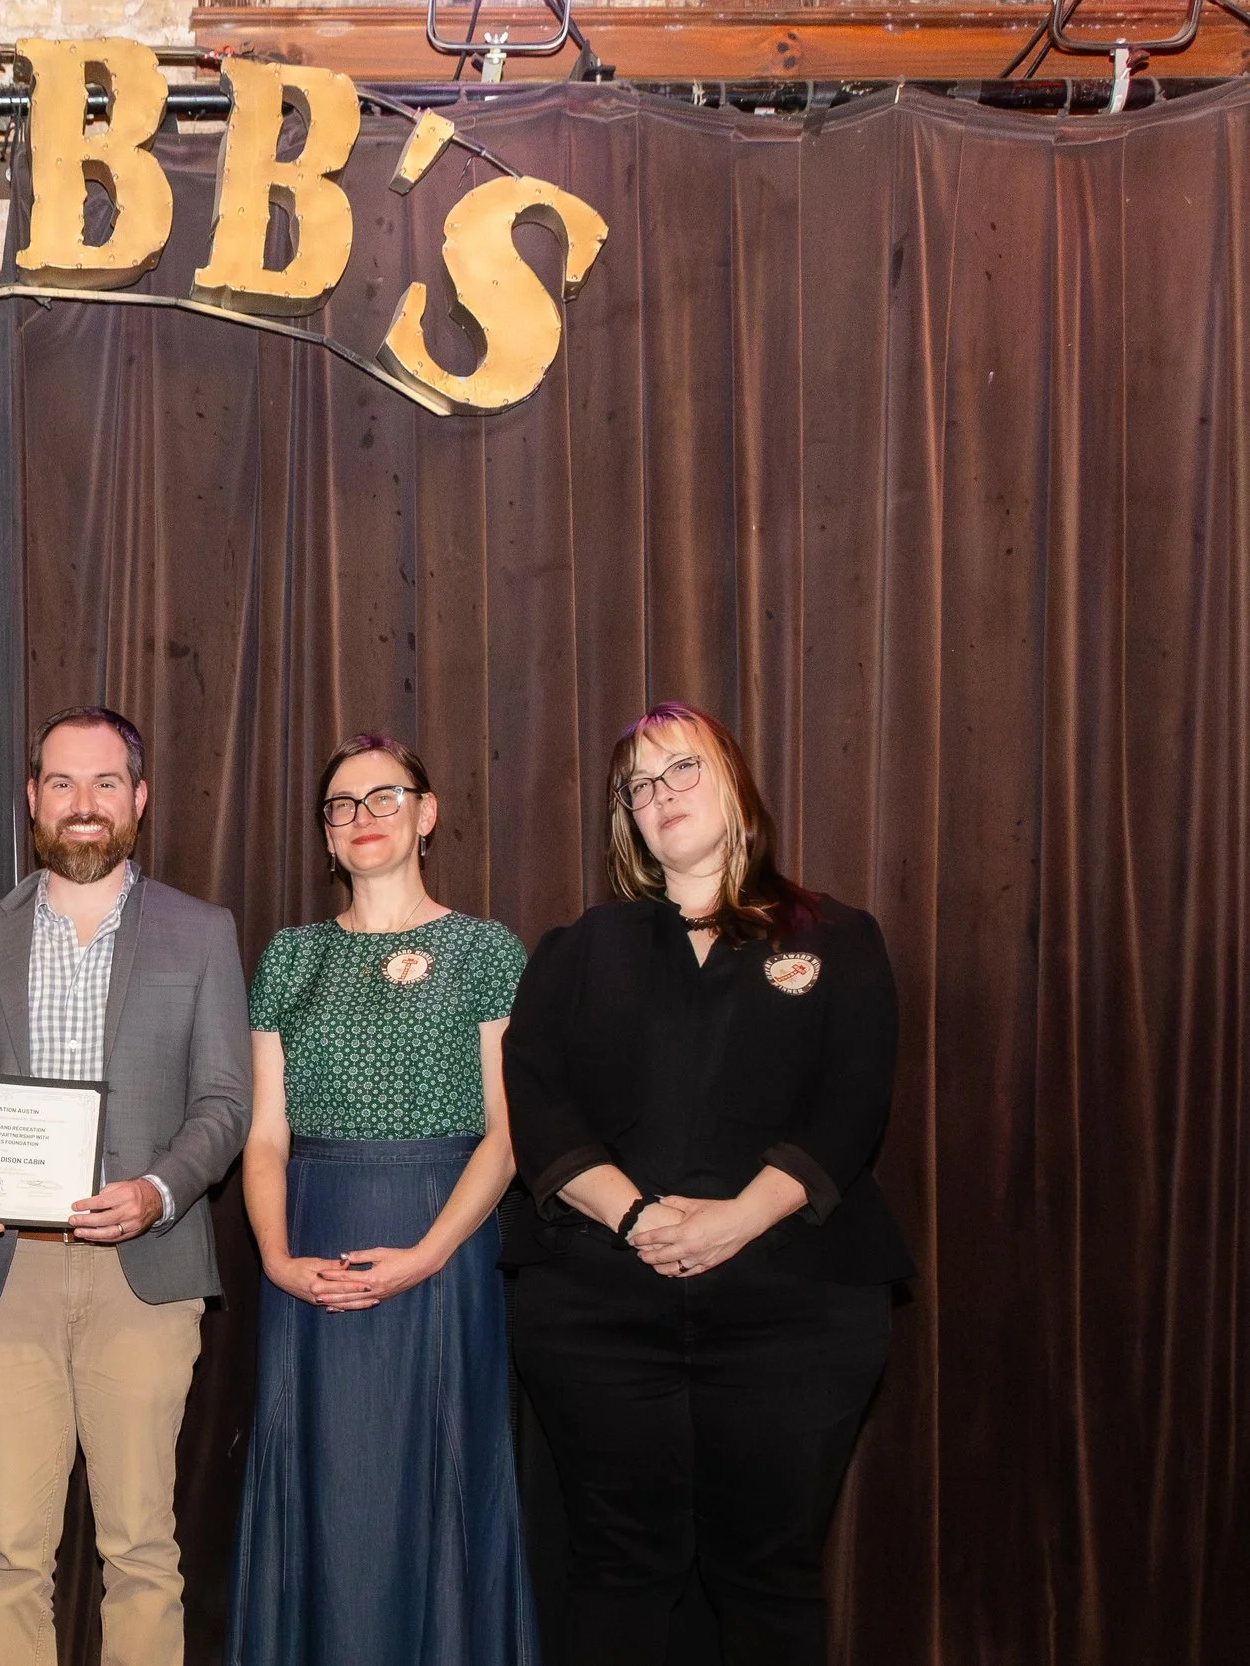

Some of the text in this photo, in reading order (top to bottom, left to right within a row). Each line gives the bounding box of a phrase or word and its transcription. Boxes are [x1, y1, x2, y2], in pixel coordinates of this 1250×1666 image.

[387, 949, 412, 961] AWARD
[782, 953, 812, 961] AWARD
[12, 1125, 46, 1133] RECREATION
[4, 1139, 39, 1147] FOUNDATION
[23, 1158, 46, 1166] CABIN
